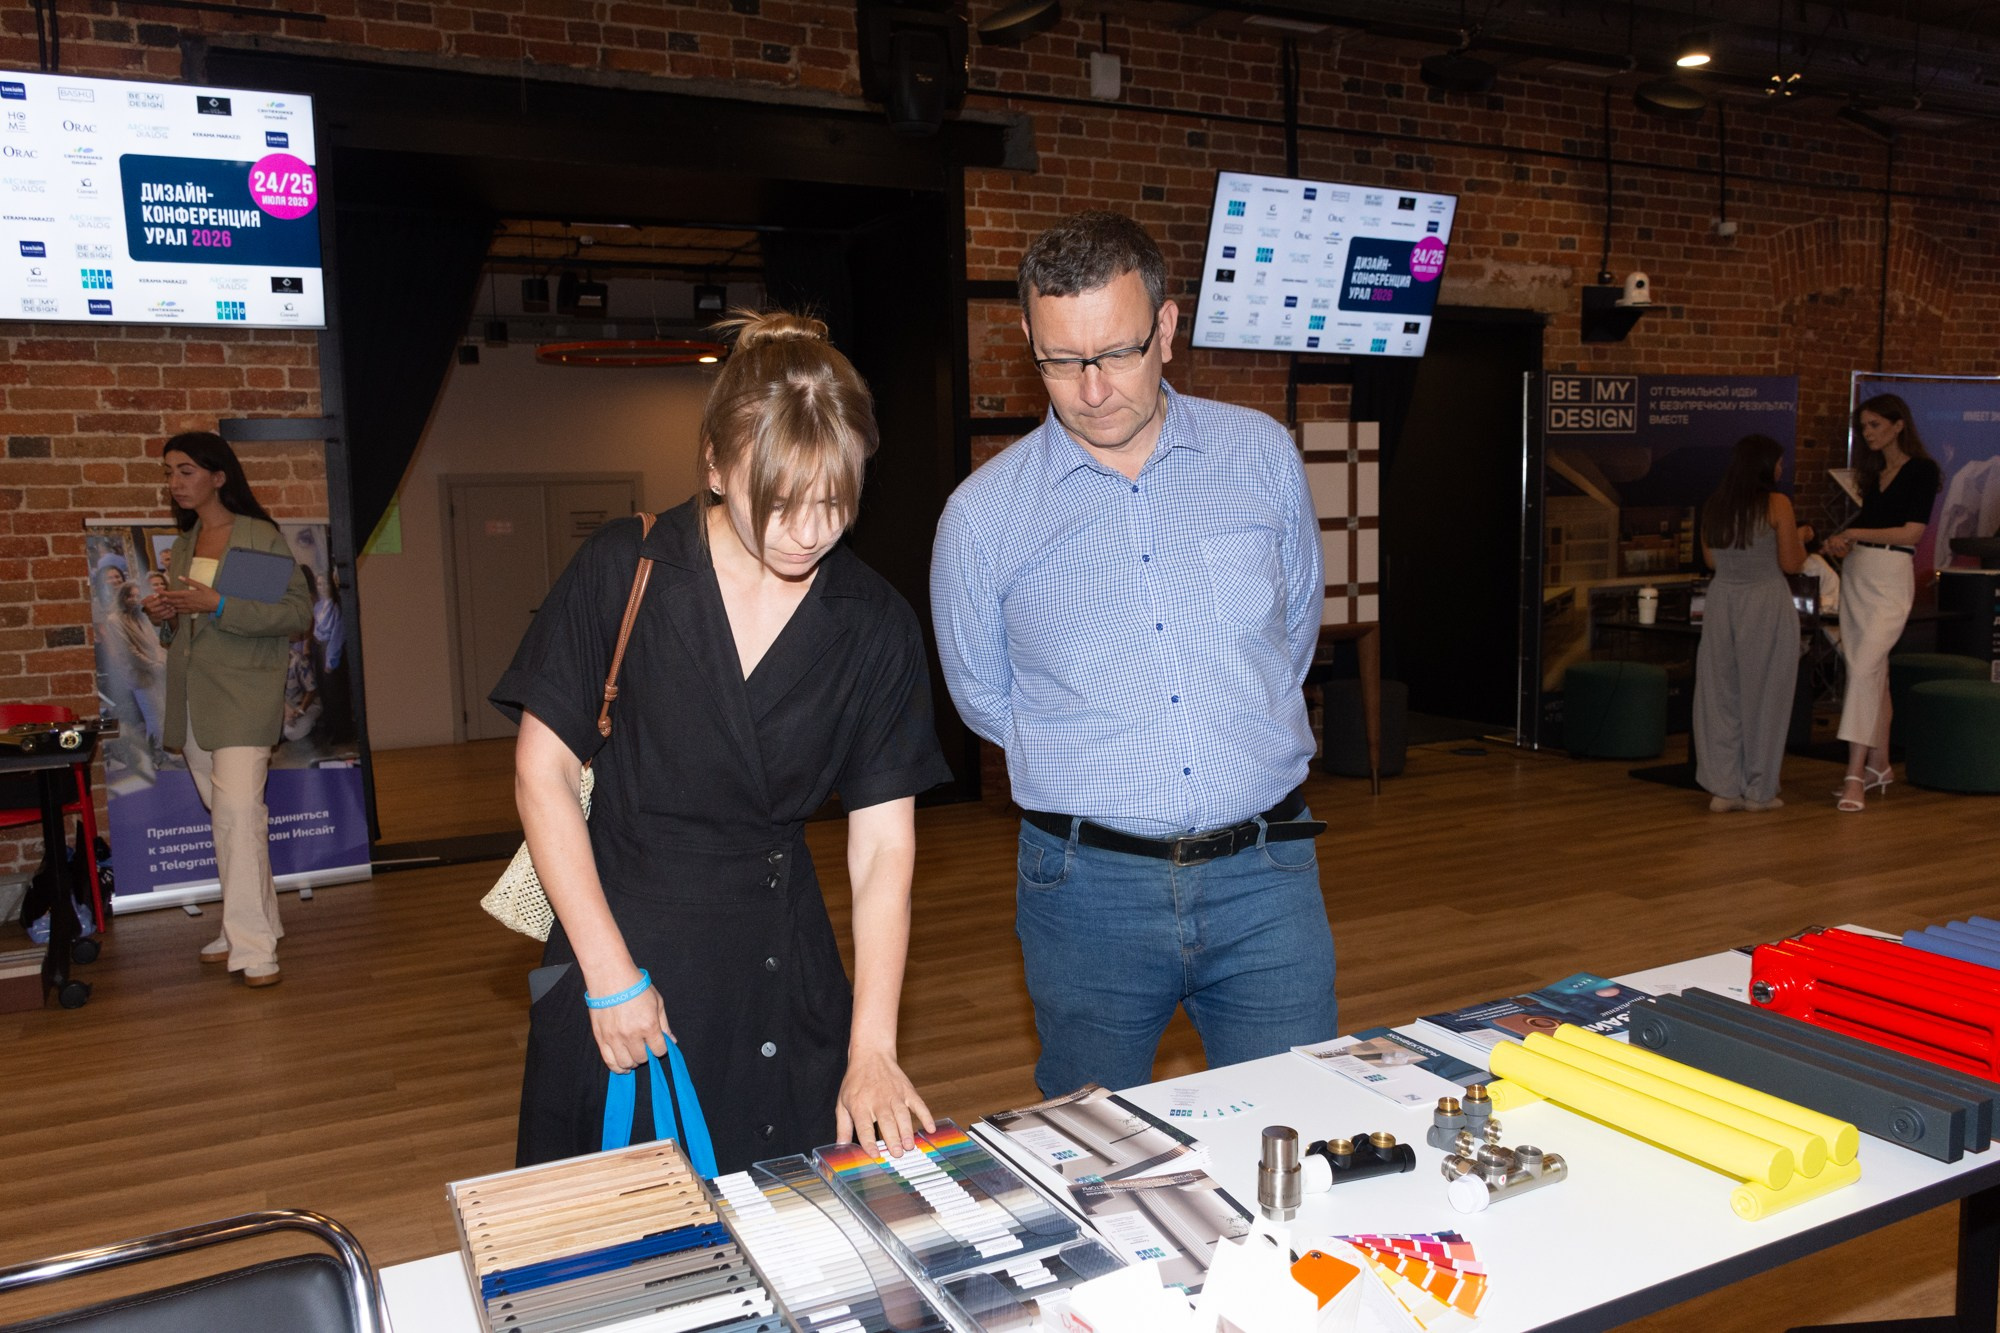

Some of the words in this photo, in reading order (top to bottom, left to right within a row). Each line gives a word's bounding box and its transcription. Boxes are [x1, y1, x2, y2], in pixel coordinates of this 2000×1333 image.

[129, 100, 163, 108] DESIGN
[254, 171, 313, 194] 24/25
[140, 182, 214, 204] ДИЗАЙН-
[262, 195, 286, 206] ИЮЛЯ
[288, 196, 308, 206] 2026
[142, 205, 261, 228] КОНФЕРЕНЦИЯ
[144, 227, 188, 246] УРАЛ
[192, 229, 232, 248] 2026
[1354, 256, 1392, 271] ДИЗАЙН-
[1412, 248, 1444, 265] 24/25
[1351, 272, 1412, 288] КОНФЕРЕНЦИЯ
[1348, 287, 1371, 300] УРАЛ
[1372, 288, 1393, 302] 2026
[1552, 381, 1580, 400] BE
[1596, 381, 1630, 400] MY
[1650, 387, 1662, 396] ОТ
[1666, 386, 1728, 398] ГЕНИАЛЬНОЙ
[1732, 388, 1756, 398] ИДЕИ
[1650, 402, 1656, 410] К
[1660, 401, 1737, 412] БЕЗУПРЕЧНОМУ
[1551, 409, 1632, 428] DESIGN
[1649, 414, 1689, 424] ВМЕСТЕ
[147, 824, 211, 839] Приглаша
[268, 811, 329, 825] единиться
[160, 840, 215, 854] закрыто
[268, 832, 290, 842] ови
[292, 826, 336, 838] Инсайт
[1582, 1011, 1630, 1032] ЗАЙН
[1387, 1033, 1440, 1057] КОНВЕКТОРЫ
